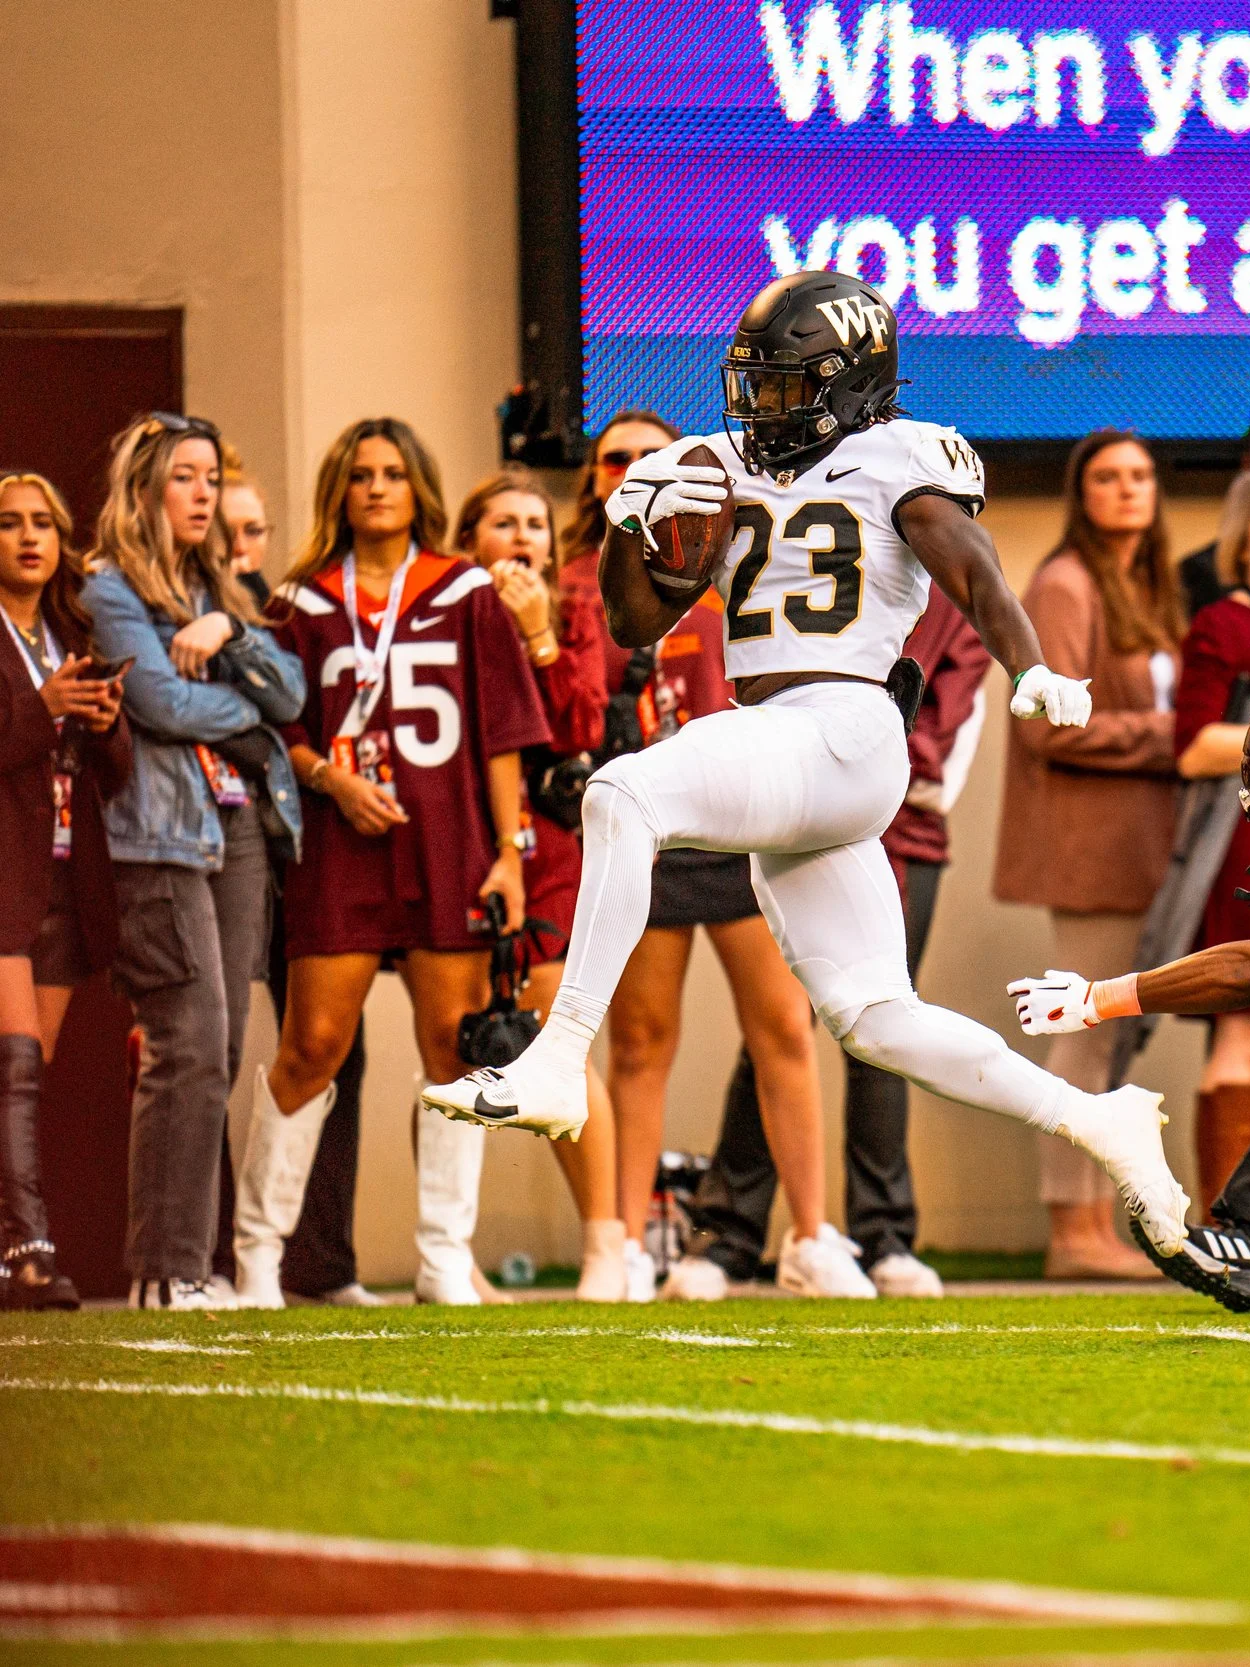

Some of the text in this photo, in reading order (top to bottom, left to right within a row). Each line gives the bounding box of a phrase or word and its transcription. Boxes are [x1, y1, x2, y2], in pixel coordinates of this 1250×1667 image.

[759, 0, 1106, 128] When
[815, 295, 889, 354] WF
[1008, 198, 1208, 346] get
[727, 499, 866, 645] 23
[320, 640, 462, 768] 25
